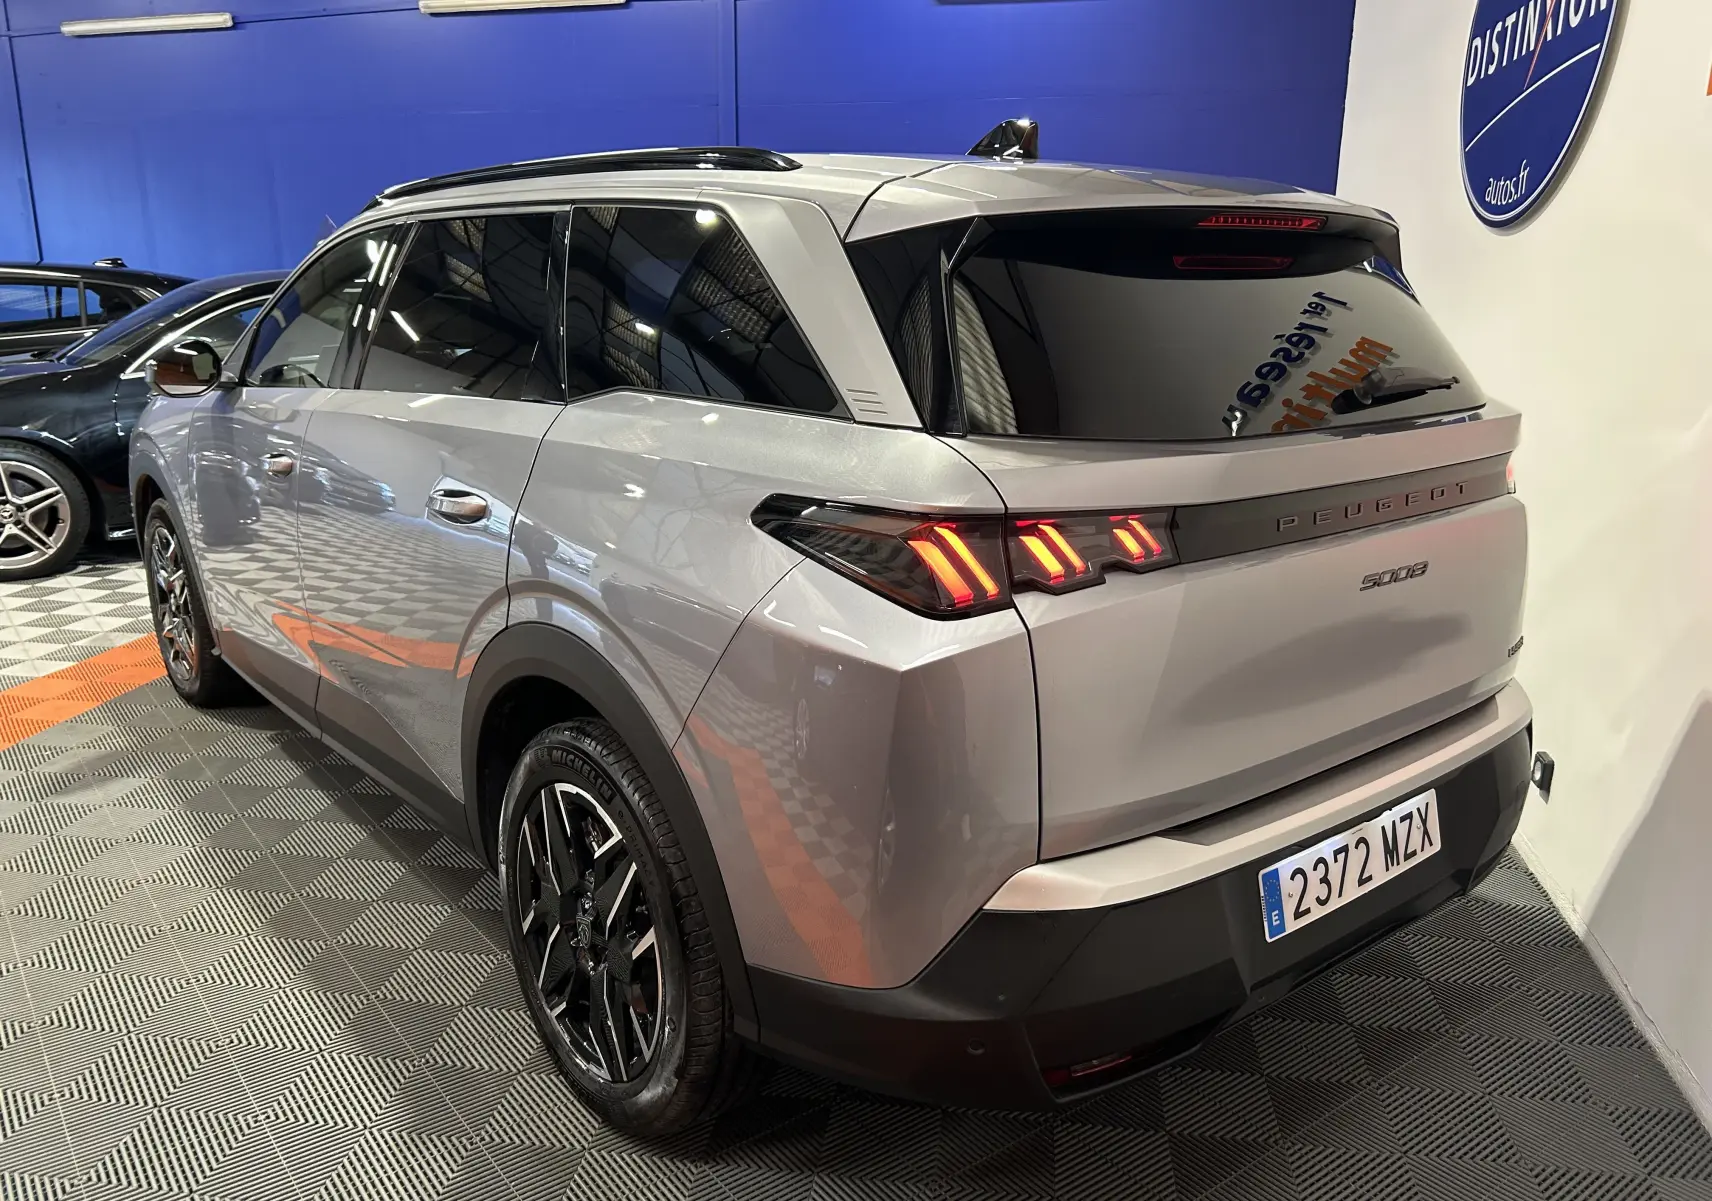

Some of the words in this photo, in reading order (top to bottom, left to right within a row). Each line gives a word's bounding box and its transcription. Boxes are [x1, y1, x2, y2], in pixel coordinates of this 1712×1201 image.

[1485, 159, 1530, 206] autos.fr
[1276, 480, 1468, 532] PEUGEOT
[1359, 560, 1429, 592] 5008
[552, 748, 614, 801] MICHELIN
[1289, 836, 1373, 921] 2372
[1380, 801, 1434, 873] MZX
[1271, 909, 1281, 926] E
